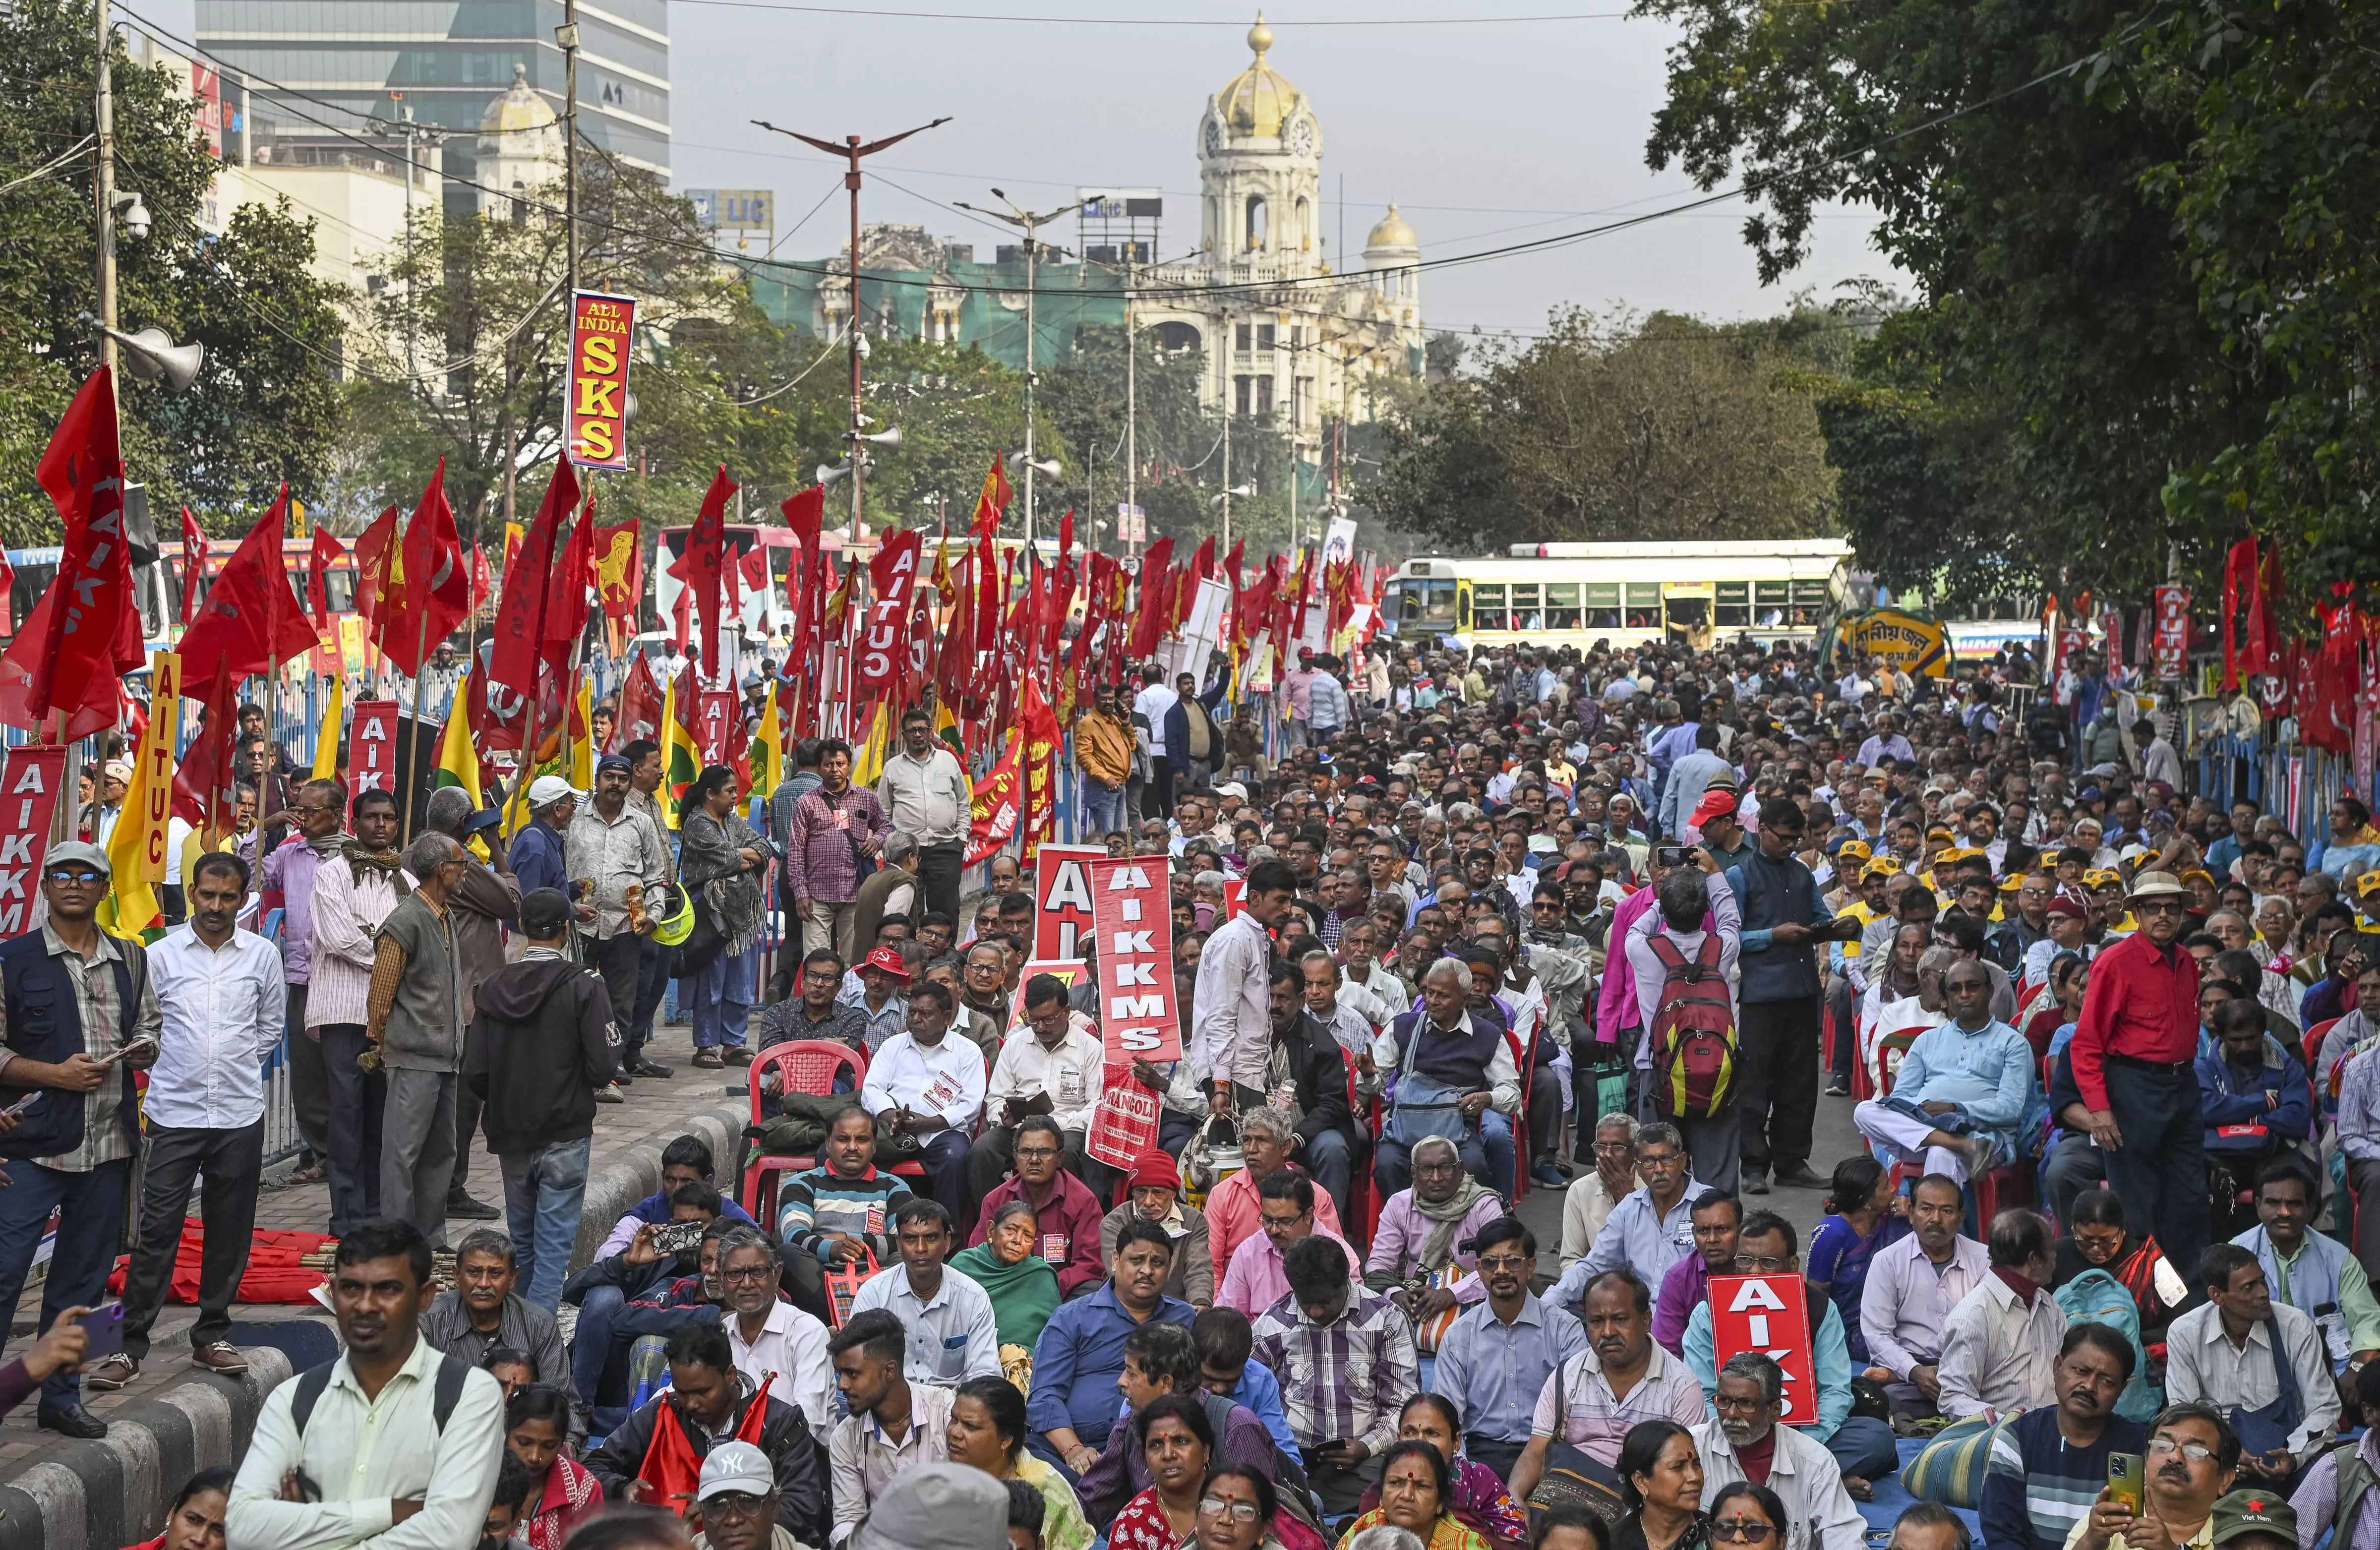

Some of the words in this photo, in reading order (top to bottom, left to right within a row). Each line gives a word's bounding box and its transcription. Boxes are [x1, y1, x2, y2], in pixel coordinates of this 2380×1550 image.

[728, 198, 765, 223] LIC
[578, 316, 628, 335] INDIA
[587, 303, 621, 318] ALL
[576, 336, 620, 460] SKS
[704, 701, 722, 768] AIK
[148, 663, 174, 865] AITUC
[0, 763, 45, 945] AIKKM
[1108, 866, 1166, 1051] AIKKMS
[1106, 1091, 1154, 1118] RANGOLI
[721, 1452, 744, 1476] NY
